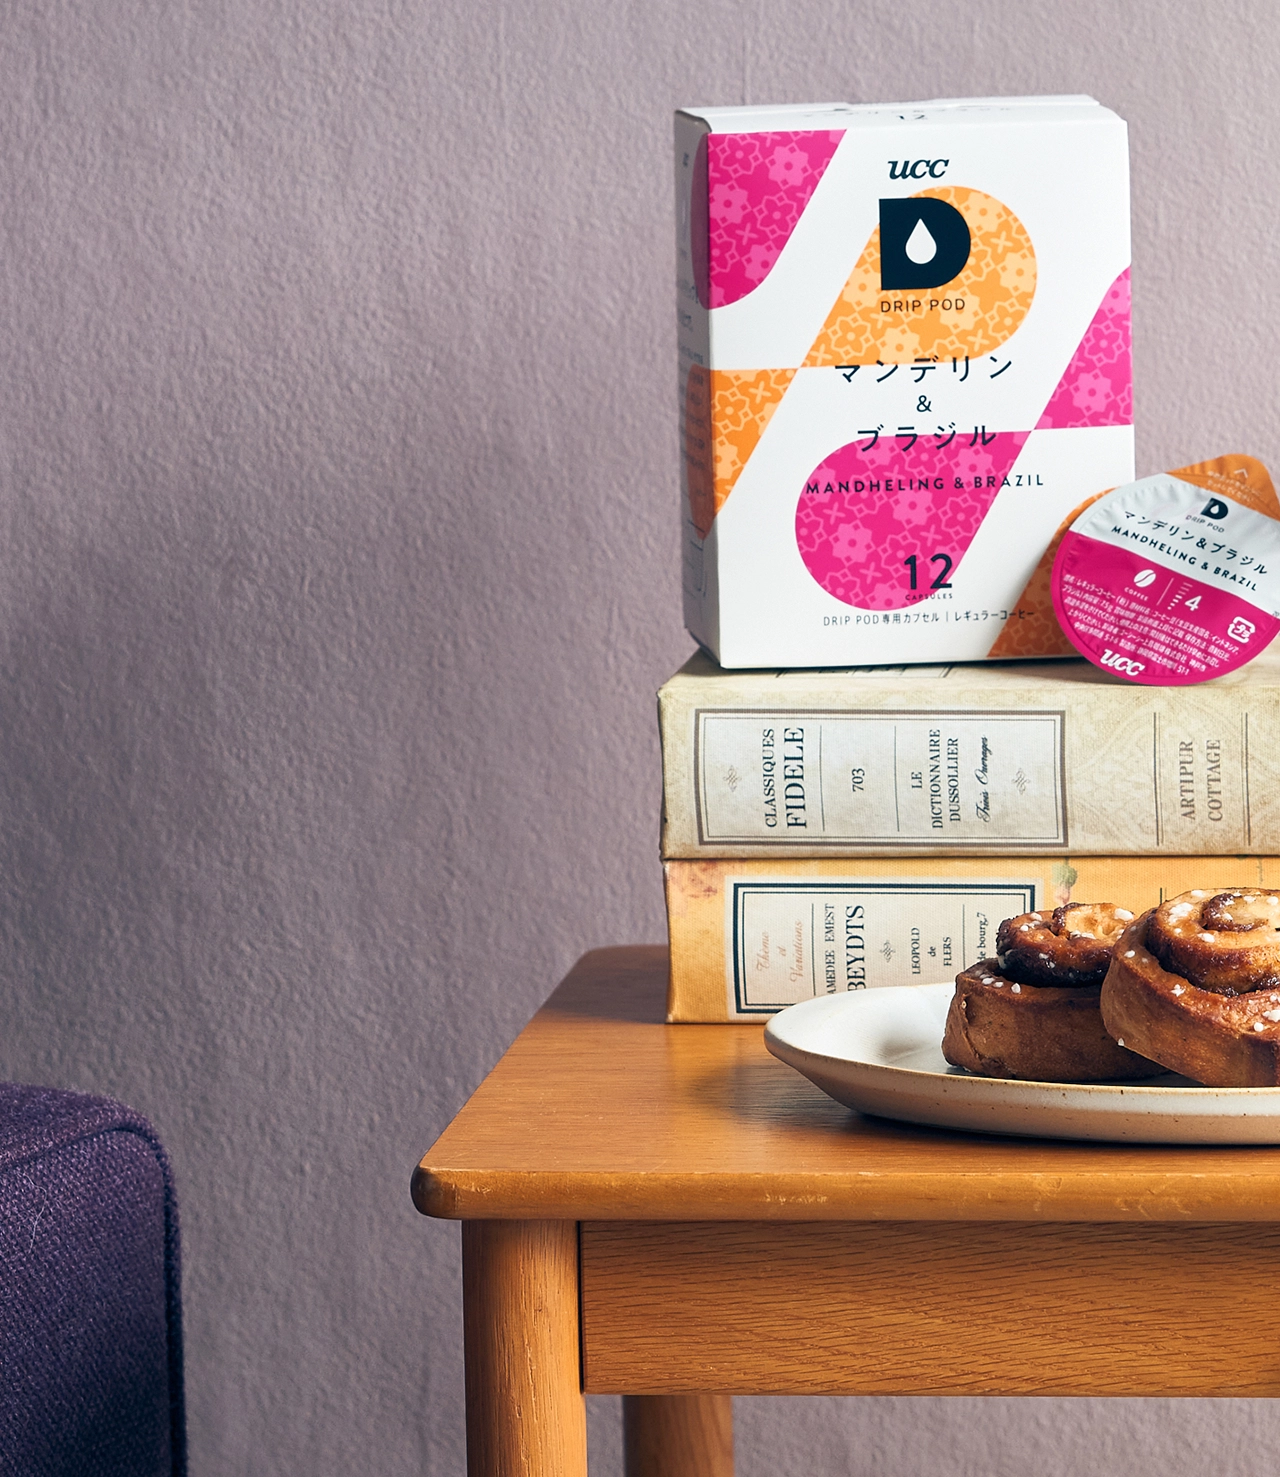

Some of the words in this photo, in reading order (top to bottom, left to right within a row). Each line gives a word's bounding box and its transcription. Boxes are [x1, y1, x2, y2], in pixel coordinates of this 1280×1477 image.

[881, 300, 922, 314] DRIP
[929, 298, 966, 312] POD
[834, 355, 1012, 383] マンデリン
[916, 395, 932, 413] &
[857, 421, 997, 452] ブラジル
[806, 477, 945, 494] MANDHELING
[954, 476, 964, 489] &
[974, 474, 1044, 488] BRAZIL
[1185, 514, 1206, 525] DRIP
[1207, 522, 1225, 534] POD
[1111, 525, 1197, 566] MANDHELING
[1200, 561, 1208, 571] &
[1213, 566, 1258, 592] BRAZIL
[1124, 511, 1268, 575] マンデリン&ブラジル
[904, 553, 953, 590] 12
[905, 593, 953, 601] CAPSULES
[1124, 587, 1149, 602] COFFEE
[1184, 595, 1203, 612] 4
[823, 615, 851, 626] DRIP
[762, 728, 777, 828] CLASSIQUES
[784, 727, 807, 829] FIDELE
[852, 768, 865, 792] 703
[911, 771, 923, 789] LE
[928, 729, 943, 829] DICTIONNAIRE
[947, 737, 961, 822] DUSSOLLIER
[1179, 740, 1196, 820] ARTIPUR
[1206, 739, 1223, 822] COTTAGE
[789, 918, 804, 983] Variations
[845, 905, 866, 991] BEYDTS
[911, 927, 920, 975] LEOPOLD
[926, 945, 936, 957] de
[942, 936, 951, 967] FLERS
[825, 950, 836, 994] AMEDEE
